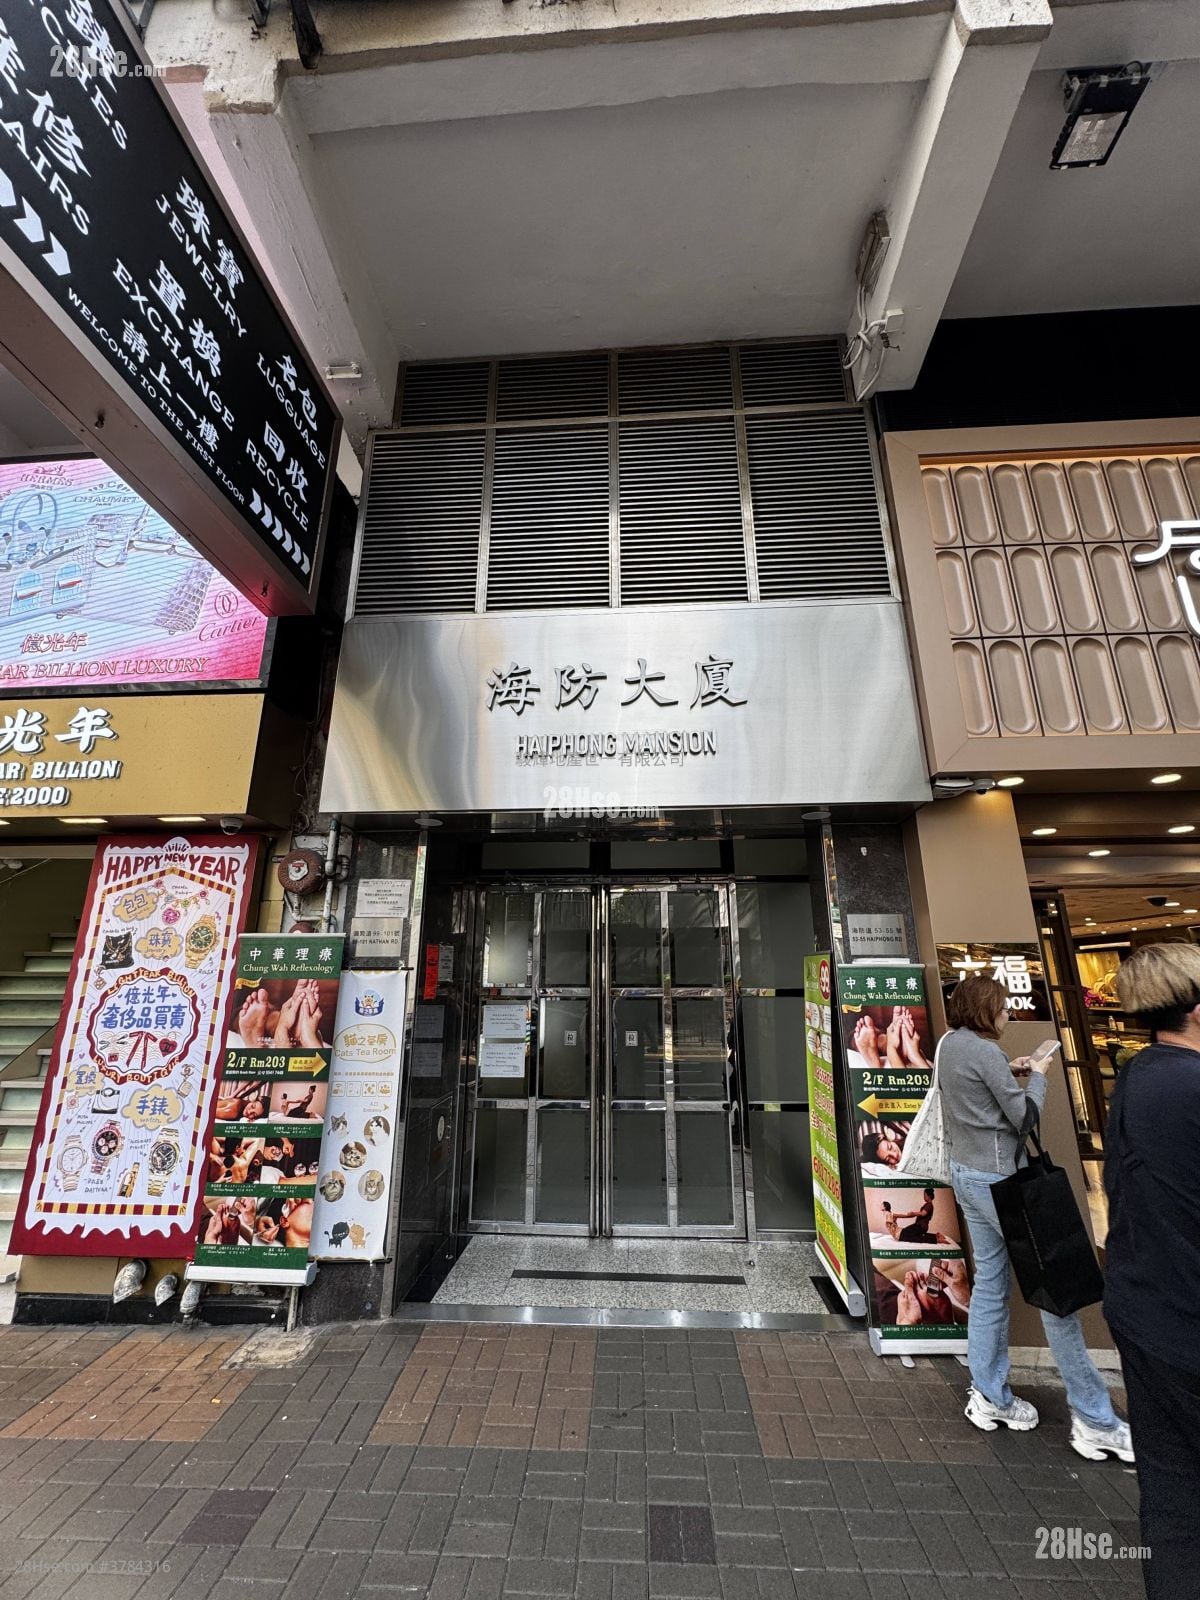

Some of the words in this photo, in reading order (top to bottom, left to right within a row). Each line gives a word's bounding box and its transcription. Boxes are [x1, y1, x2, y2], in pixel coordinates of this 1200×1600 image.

[29, 0, 127, 150] CHES
[0, 95, 91, 236] AIRS
[176, 176, 244, 299] 珠寶
[156, 194, 247, 337] JEWELRY
[149, 260, 221, 377] 置換
[113, 258, 235, 431] EXCHANGE
[68, 287, 137, 377] WELCOME
[141, 376, 156, 398] TO
[160, 399, 183, 432] THE
[185, 431, 216, 467] FIRST
[216, 467, 245, 505] FLOOR
[122, 318, 219, 452] 請上一樓
[276, 354, 318, 431] 名包
[258, 353, 326, 469] LUGGUAGE
[264, 421, 308, 503] 回收
[245, 438, 309, 532] RECYCLE
[20, 632, 88, 653] 億光年
[199, 616, 261, 642] Cartier
[0, 663, 29, 679] AR
[32, 660, 119, 679] BILLION
[123, 657, 210, 676] LUXURY
[486, 654, 748, 716] 海防大廈
[516, 732, 617, 759] HAIPHONG
[621, 729, 718, 757] MANSION
[31, 760, 122, 780] BILLION
[10, 786, 70, 807] 2000
[104, 853, 164, 885] HAPPY
[164, 852, 188, 863] NEW
[189, 855, 240, 886] YEAR
[250, 946, 333, 962] 中華理療
[243, 963, 269, 974] Chung
[271, 964, 288, 972] Wah
[290, 963, 335, 974] Reflexology
[124, 984, 171, 1005] 億光年
[843, 992, 866, 1001] Chung
[867, 992, 883, 1000] Wah
[885, 992, 922, 1002] Reflexology
[845, 976, 919, 990] 中華理療
[101, 1003, 188, 1029] 奢侈品買賣
[227, 1051, 248, 1068] 2/F
[250, 1056, 286, 1068] Rm203
[356, 1048, 371, 1056] Tea
[372, 1047, 397, 1056] Room
[863, 1072, 884, 1085] 2/F
[888, 1075, 930, 1086] Rm203
[136, 1093, 171, 1117] 手錶
